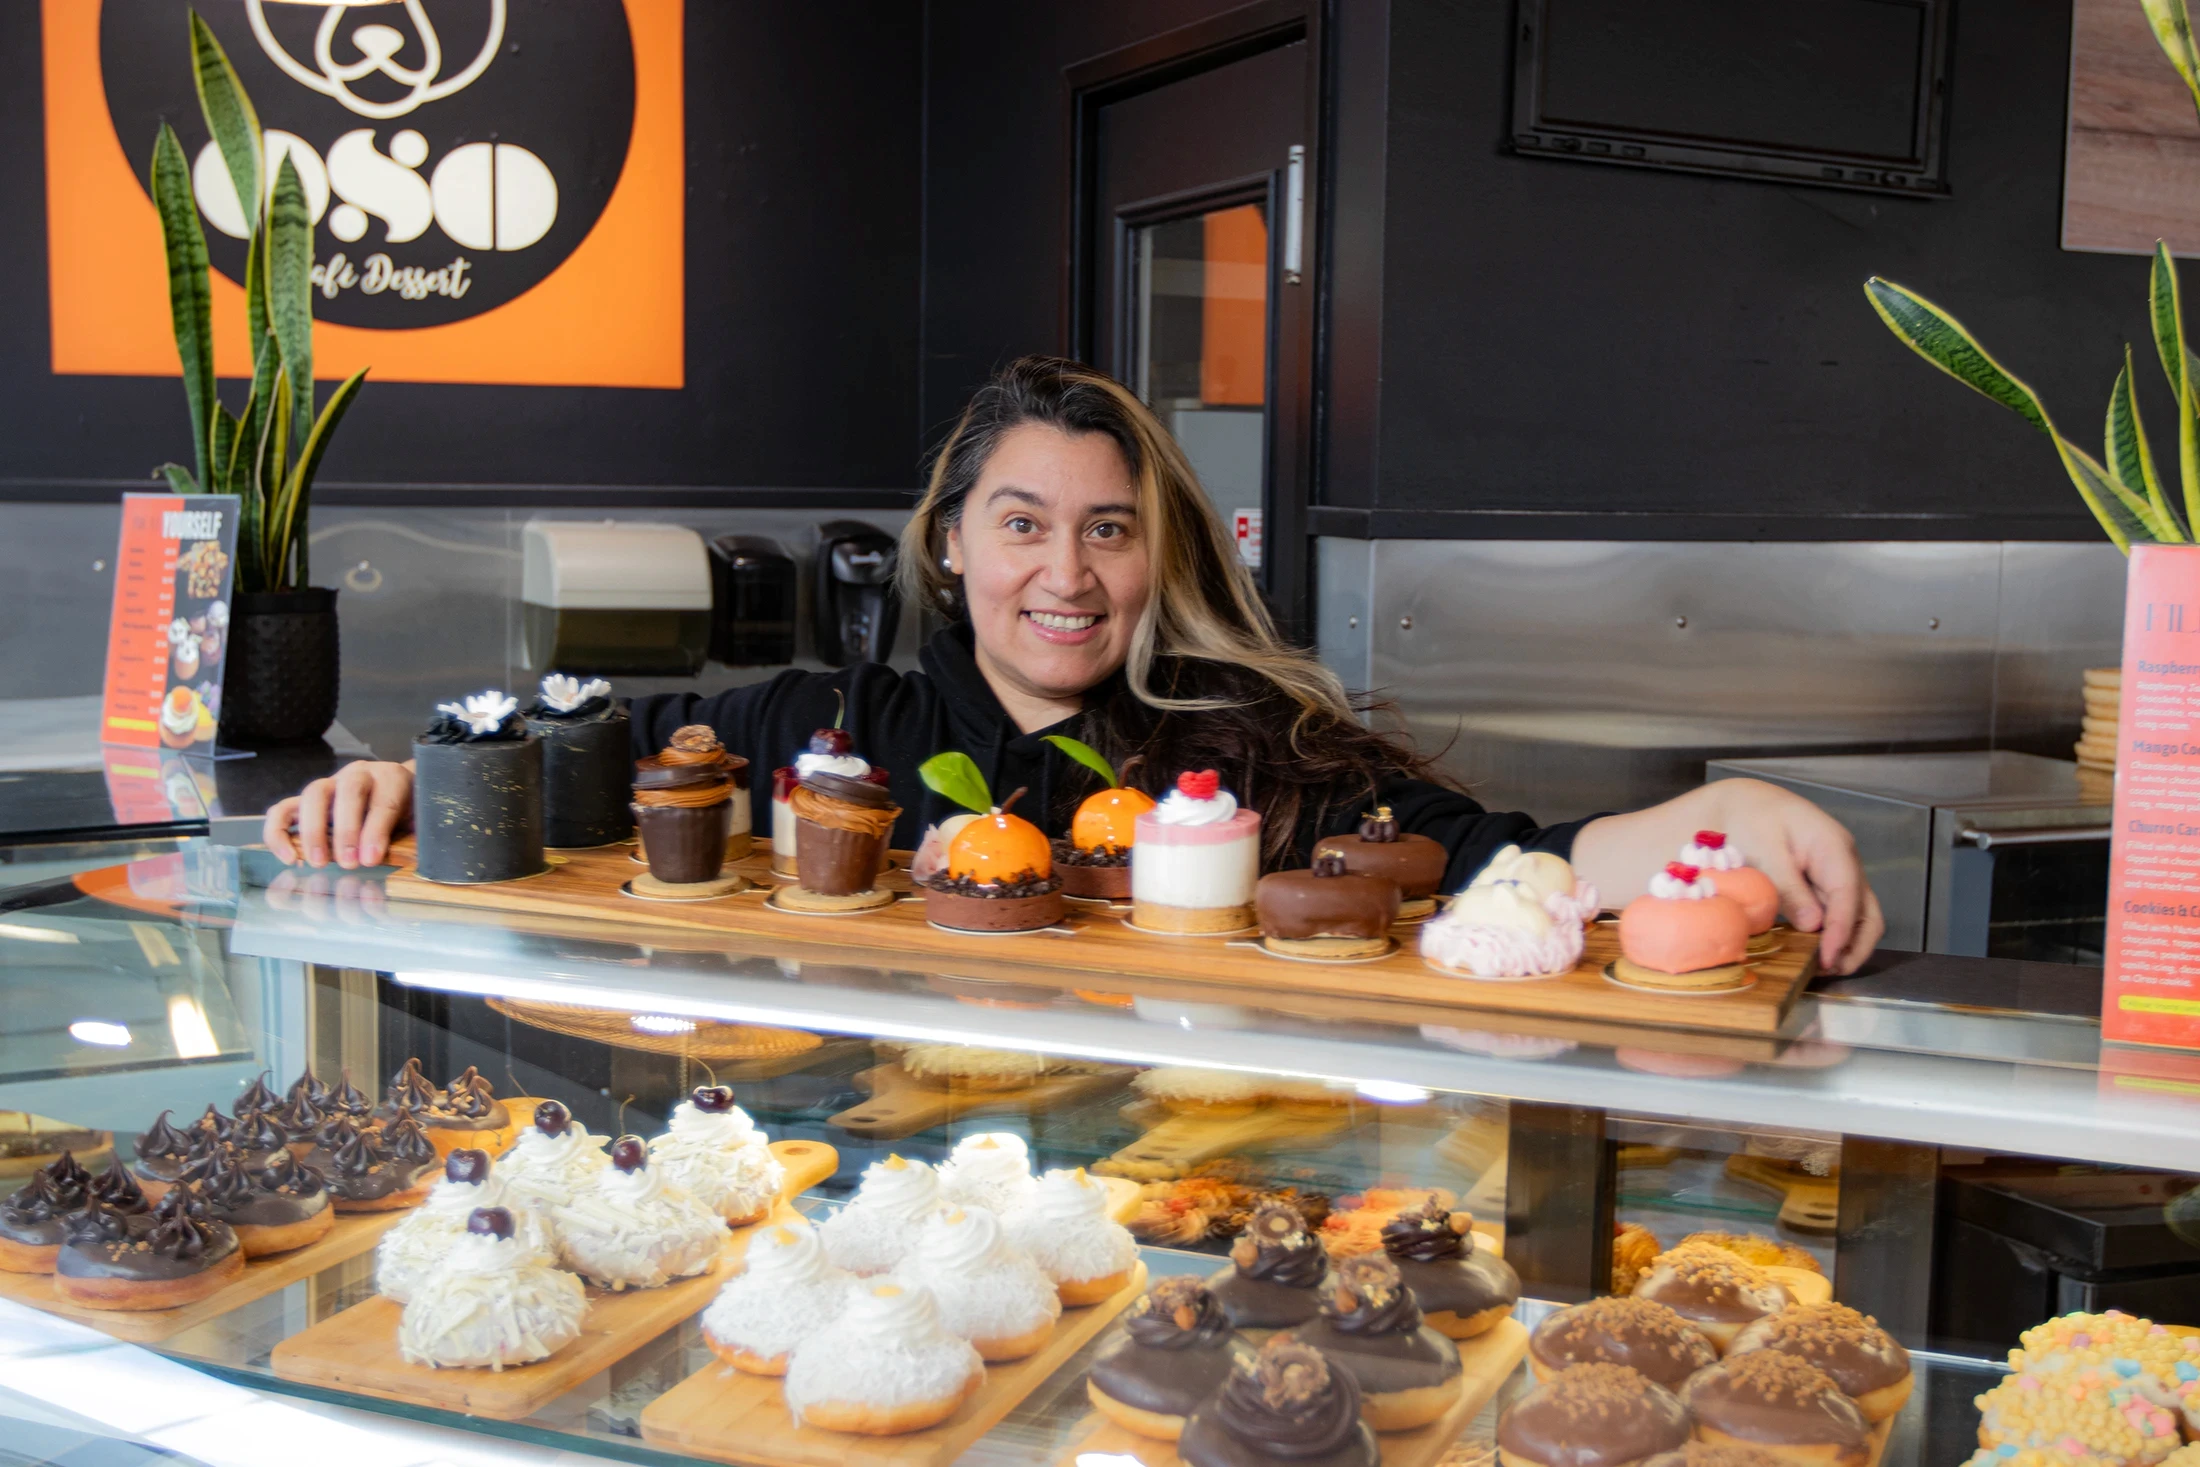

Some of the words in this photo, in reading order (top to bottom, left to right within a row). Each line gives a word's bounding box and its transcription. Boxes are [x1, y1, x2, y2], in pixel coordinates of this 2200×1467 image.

[312, 252, 360, 299] afé
[360, 252, 473, 300] Dessert
[162, 510, 223, 540] YOURSELF
[2145, 603, 2200, 635] FIL
[2137, 659, 2200, 676] Raspberr
[2132, 740, 2178, 758] Mango
[2128, 819, 2174, 835] Churro
[2177, 822, 2200, 837] Car
[2123, 900, 2176, 917] Cookies
[2178, 903, 2188, 917] &
